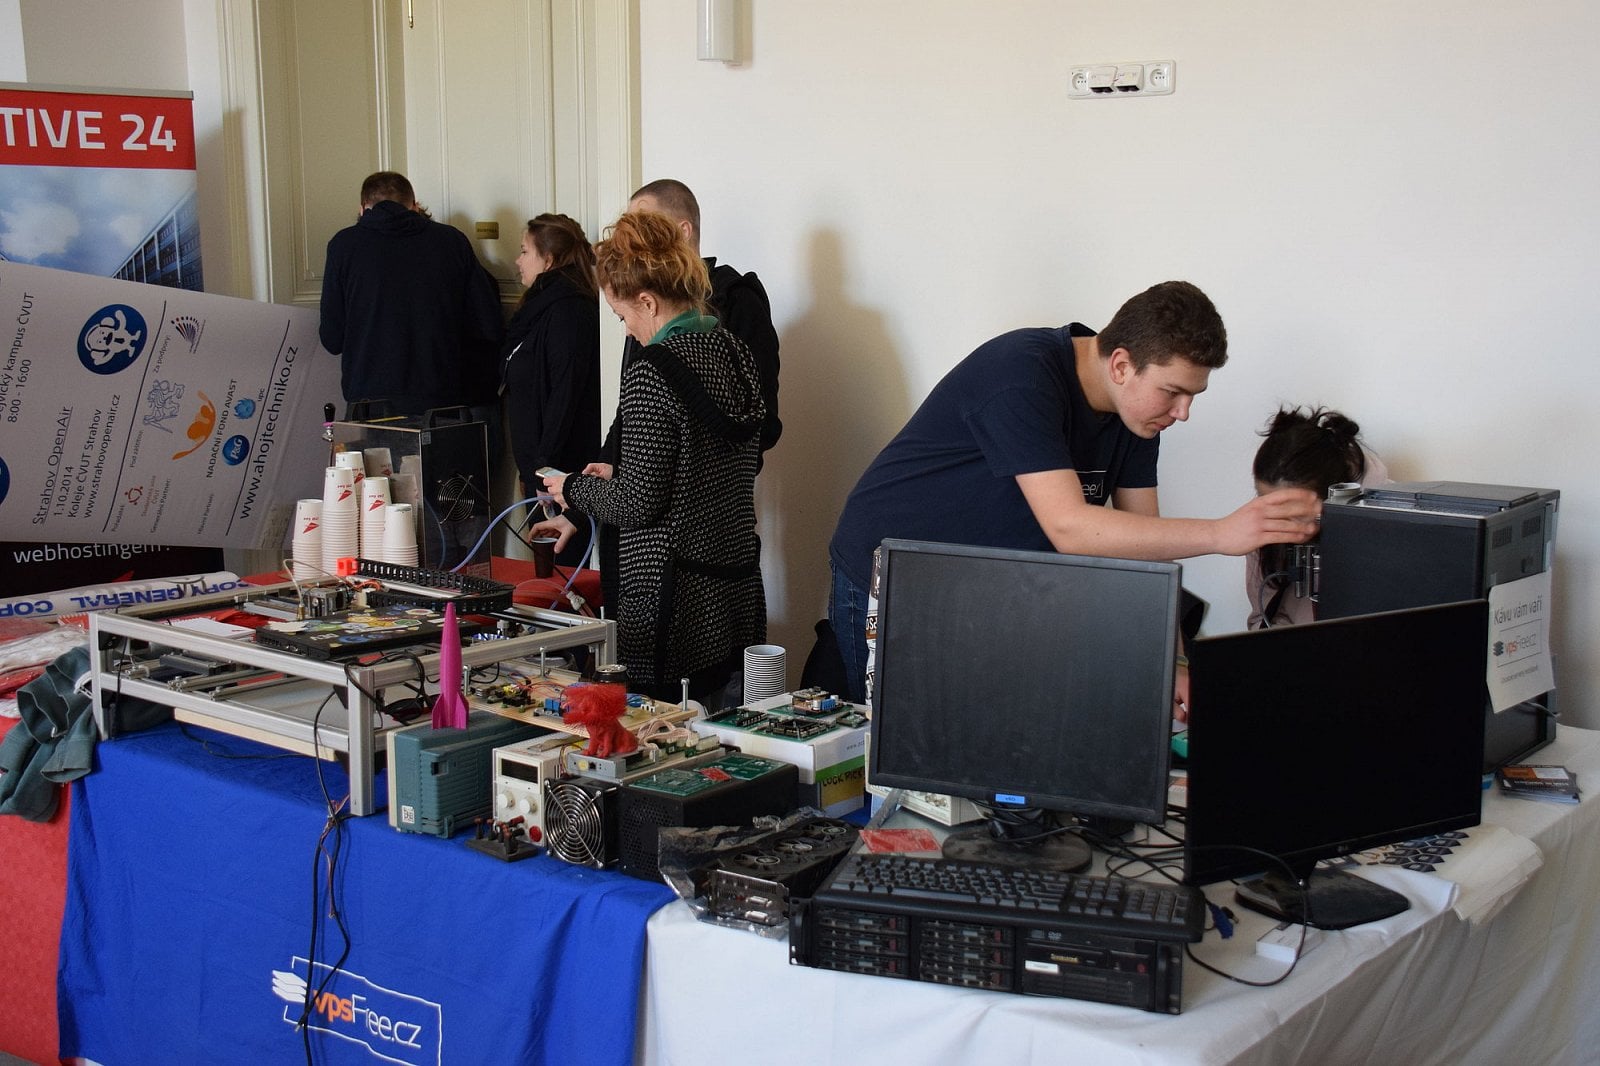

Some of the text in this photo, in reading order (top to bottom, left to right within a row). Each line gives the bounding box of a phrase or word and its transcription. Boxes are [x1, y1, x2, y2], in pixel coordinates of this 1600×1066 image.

[0, 107, 177, 152] TIVE 24
[3, 327, 26, 371] kampus
[16, 292, 35, 325] ČVUT
[7, 399, 22, 423] 8:00
[15, 359, 32, 388] 16:00
[257, 388, 266, 403] upc
[83, 394, 121, 519] www.strahovopenair.cz
[206, 378, 238, 479] NADAČNÍ FOND AVAST
[229, 437, 243, 460] P&G
[240, 346, 299, 520] www.ahojtechniko.cz
[32, 406, 72, 525] Strahov OpenAir
[53, 466, 75, 517] 1.10.2014
[67, 409, 102, 518] Koleje ČVUT Strahov
[70, 587, 184, 608] GENERAL
[1494, 595, 1543, 626] Kávu vám vaří
[822, 773, 844, 787] LOCK
[312, 989, 422, 1049] vpsFree.cz
